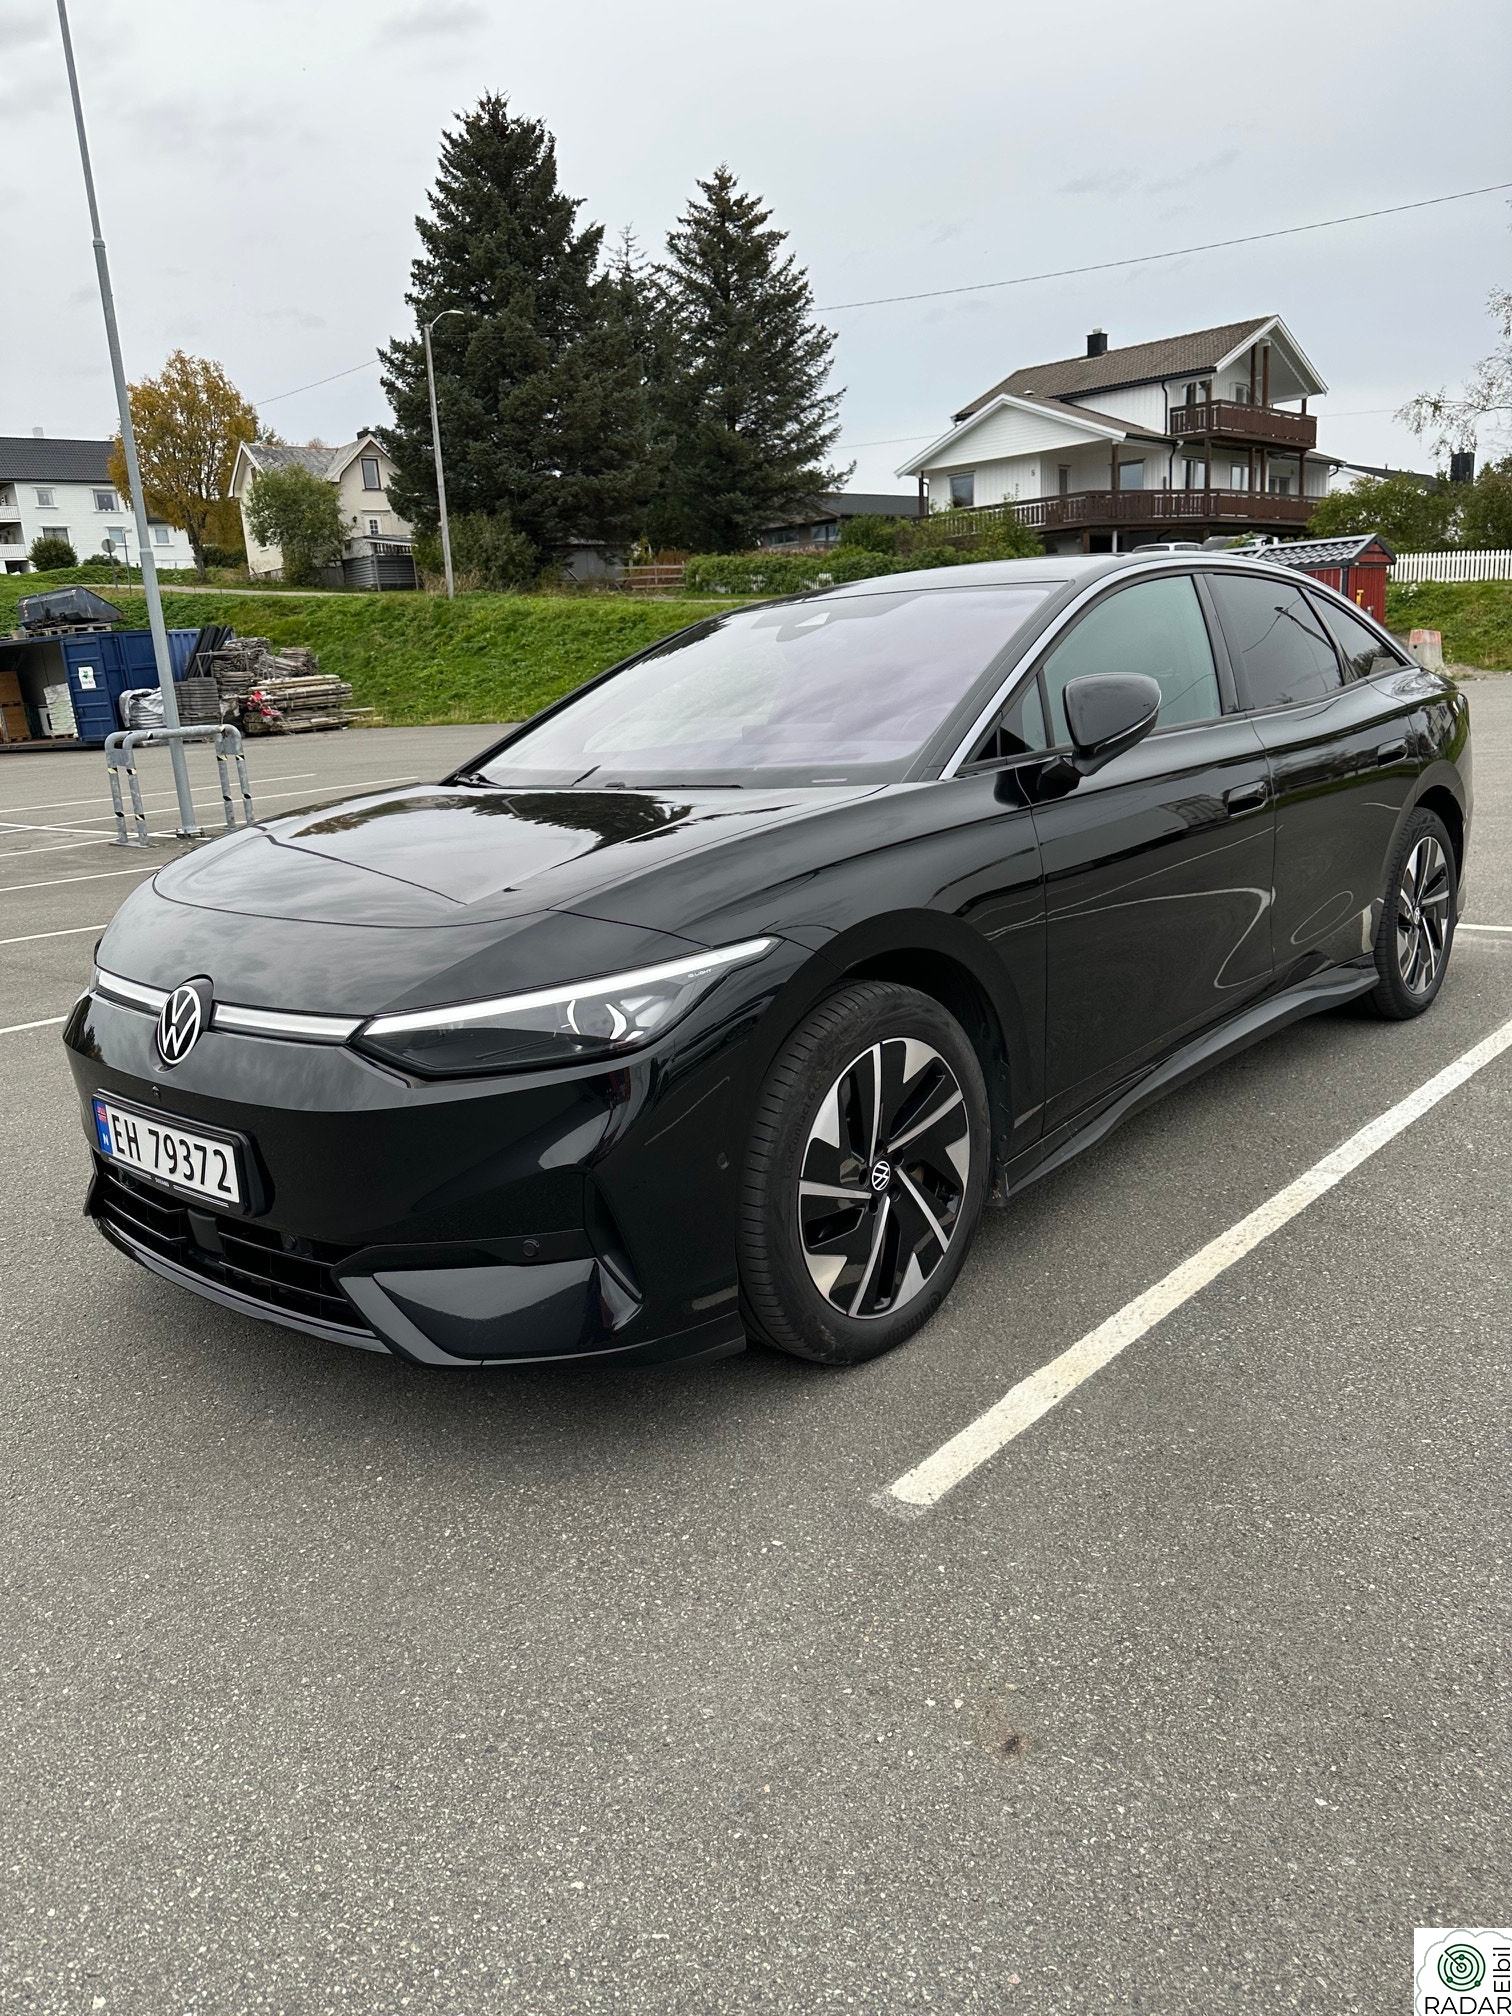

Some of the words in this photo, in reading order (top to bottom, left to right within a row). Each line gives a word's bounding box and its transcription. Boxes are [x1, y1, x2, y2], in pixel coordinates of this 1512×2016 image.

[159, 987, 200, 1063] VW
[102, 1133, 109, 1146] N
[111, 1113, 141, 1162] EH
[148, 1128, 232, 1194] 79372
[872, 1161, 890, 1190] VW
